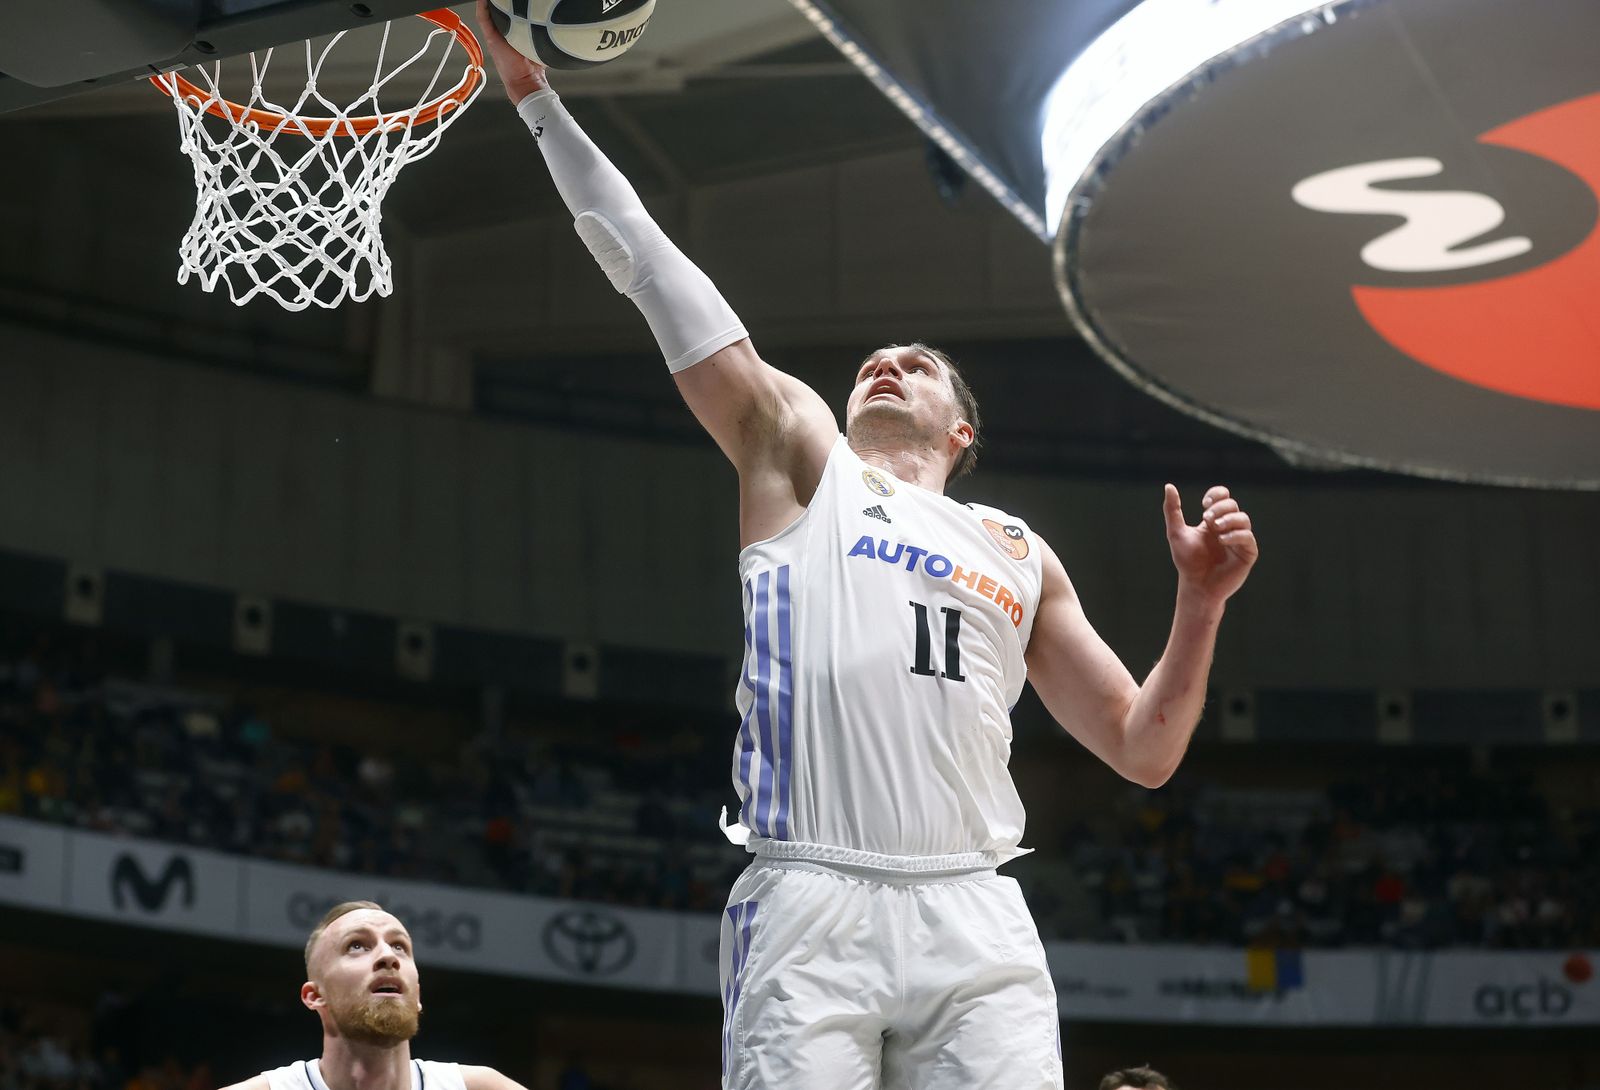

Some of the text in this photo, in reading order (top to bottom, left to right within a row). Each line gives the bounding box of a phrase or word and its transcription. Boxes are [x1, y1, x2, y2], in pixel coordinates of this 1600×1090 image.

[596, 16, 650, 51] DING
[863, 509, 892, 524] adidas
[847, 535, 1024, 628] AUTOHERO
[909, 600, 966, 682] 11
[1474, 976, 1574, 1020] acb
